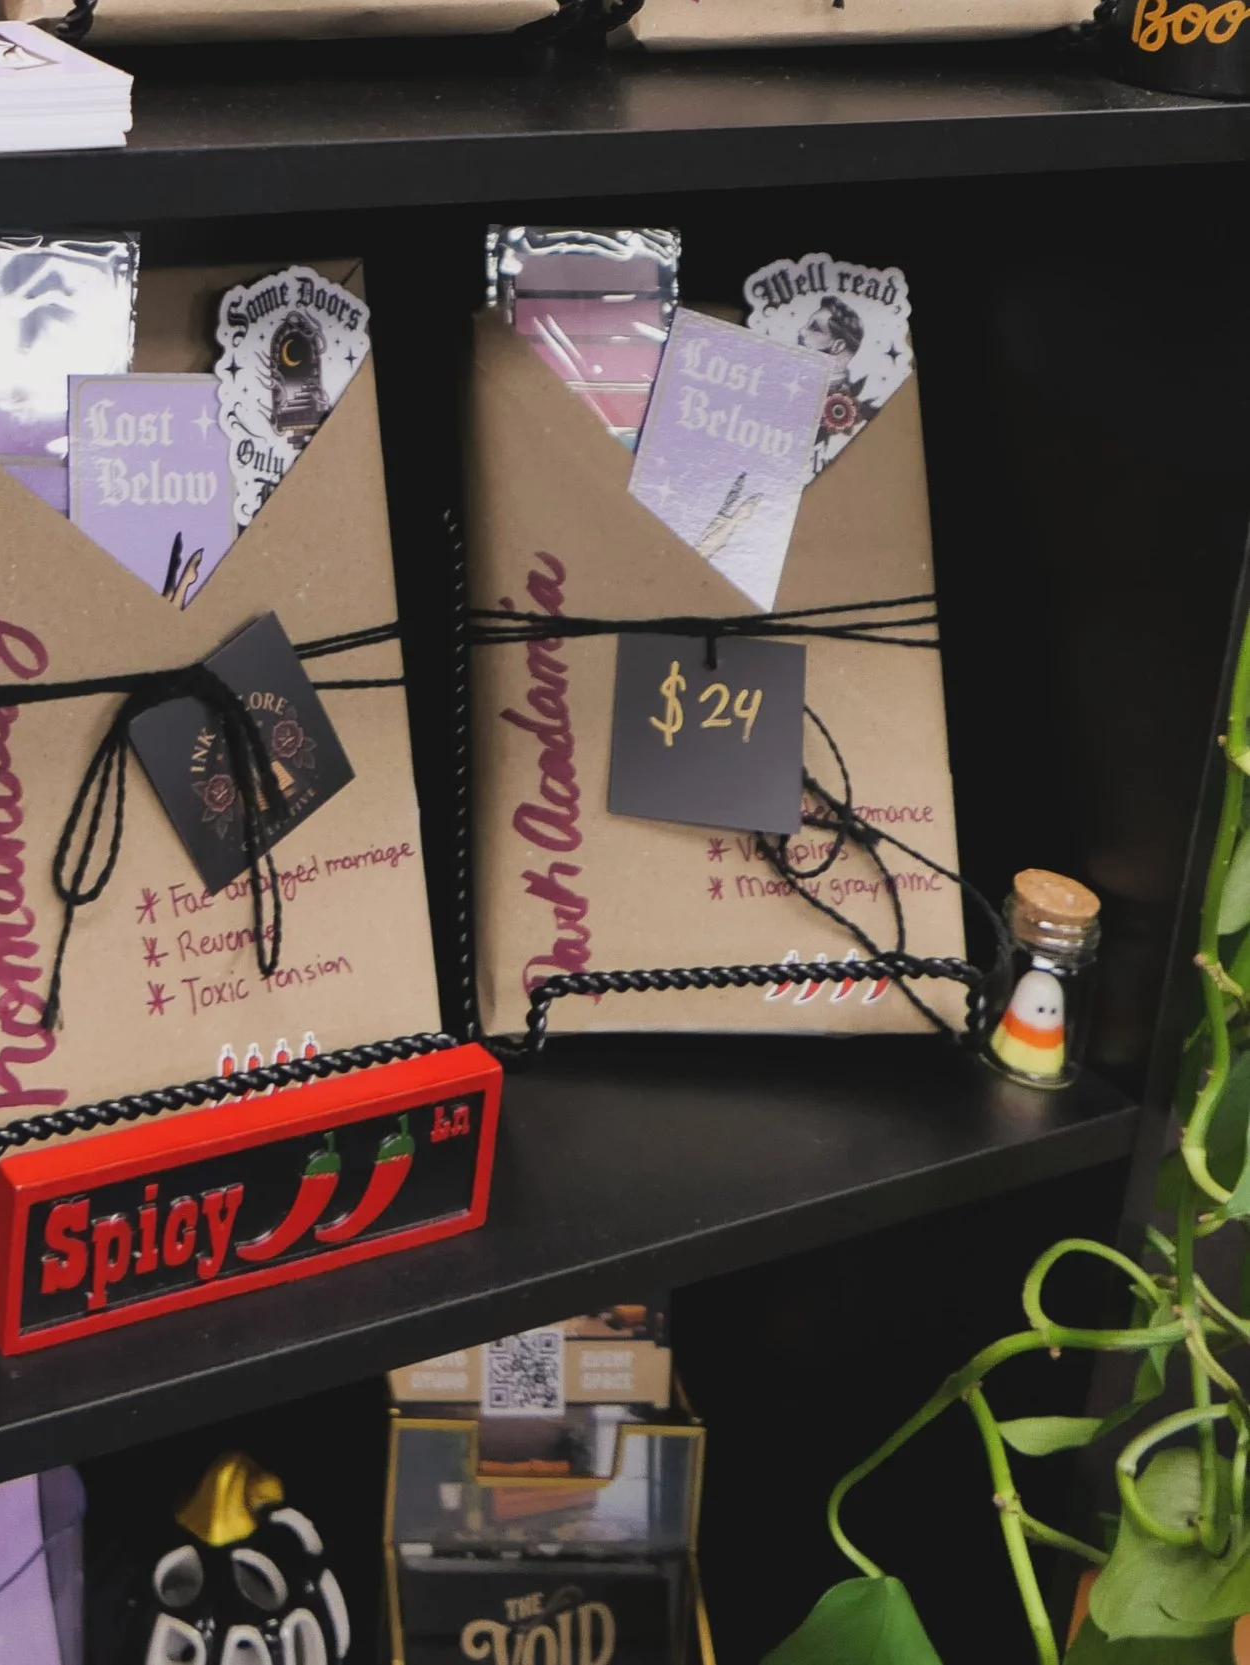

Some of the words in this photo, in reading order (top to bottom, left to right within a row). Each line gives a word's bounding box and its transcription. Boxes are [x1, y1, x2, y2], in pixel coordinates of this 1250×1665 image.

[227, 281, 293, 348] Some
[294, 276, 364, 332] Doors
[752, 264, 827, 317] Well
[681, 339, 765, 398] Lost
[83, 397, 174, 449] Lost
[676, 386, 795, 459] Below
[96, 456, 219, 507] Below
[245, 692, 288, 715] ORE
[854, 804, 934, 823] omance
[737, 837, 849, 865] Vpires
[169, 884, 214, 917] Fae
[225, 855, 319, 901] aranged
[830, 876, 880, 906] gray
[177, 924, 276, 963] Revene
[181, 971, 250, 1015] Toxic
[40, 1182, 244, 1311] Spicy
